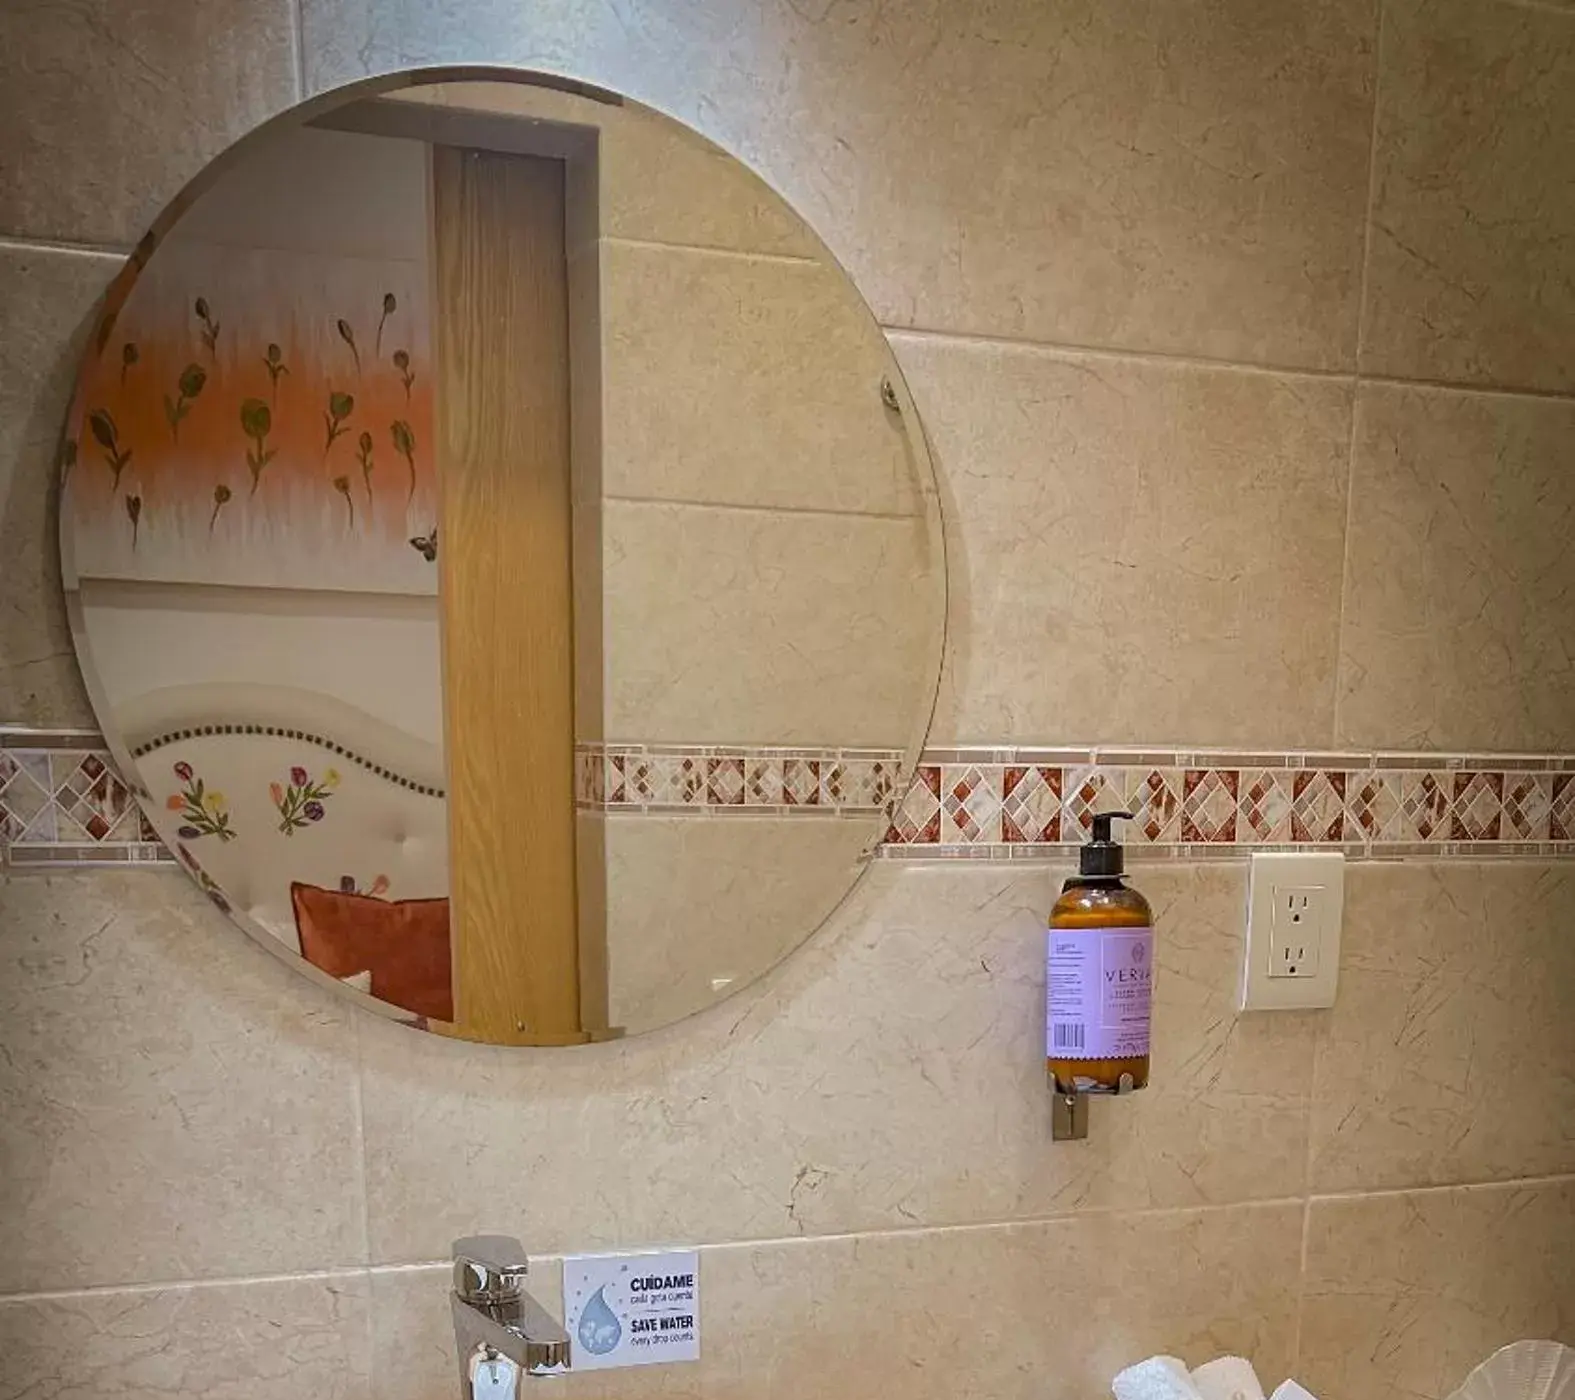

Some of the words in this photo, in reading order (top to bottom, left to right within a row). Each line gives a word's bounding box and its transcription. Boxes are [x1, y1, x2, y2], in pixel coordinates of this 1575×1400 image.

[630, 1274, 693, 1292] CUÍDAME
[630, 1294, 648, 1304] cada
[650, 1294, 667, 1304] gota
[668, 1291, 693, 1301] cuenta
[631, 1318, 657, 1333] SAVE
[660, 1315, 693, 1330] WATER
[631, 1336, 650, 1346] every
[652, 1333, 669, 1344] drop
[670, 1332, 693, 1343] counts
